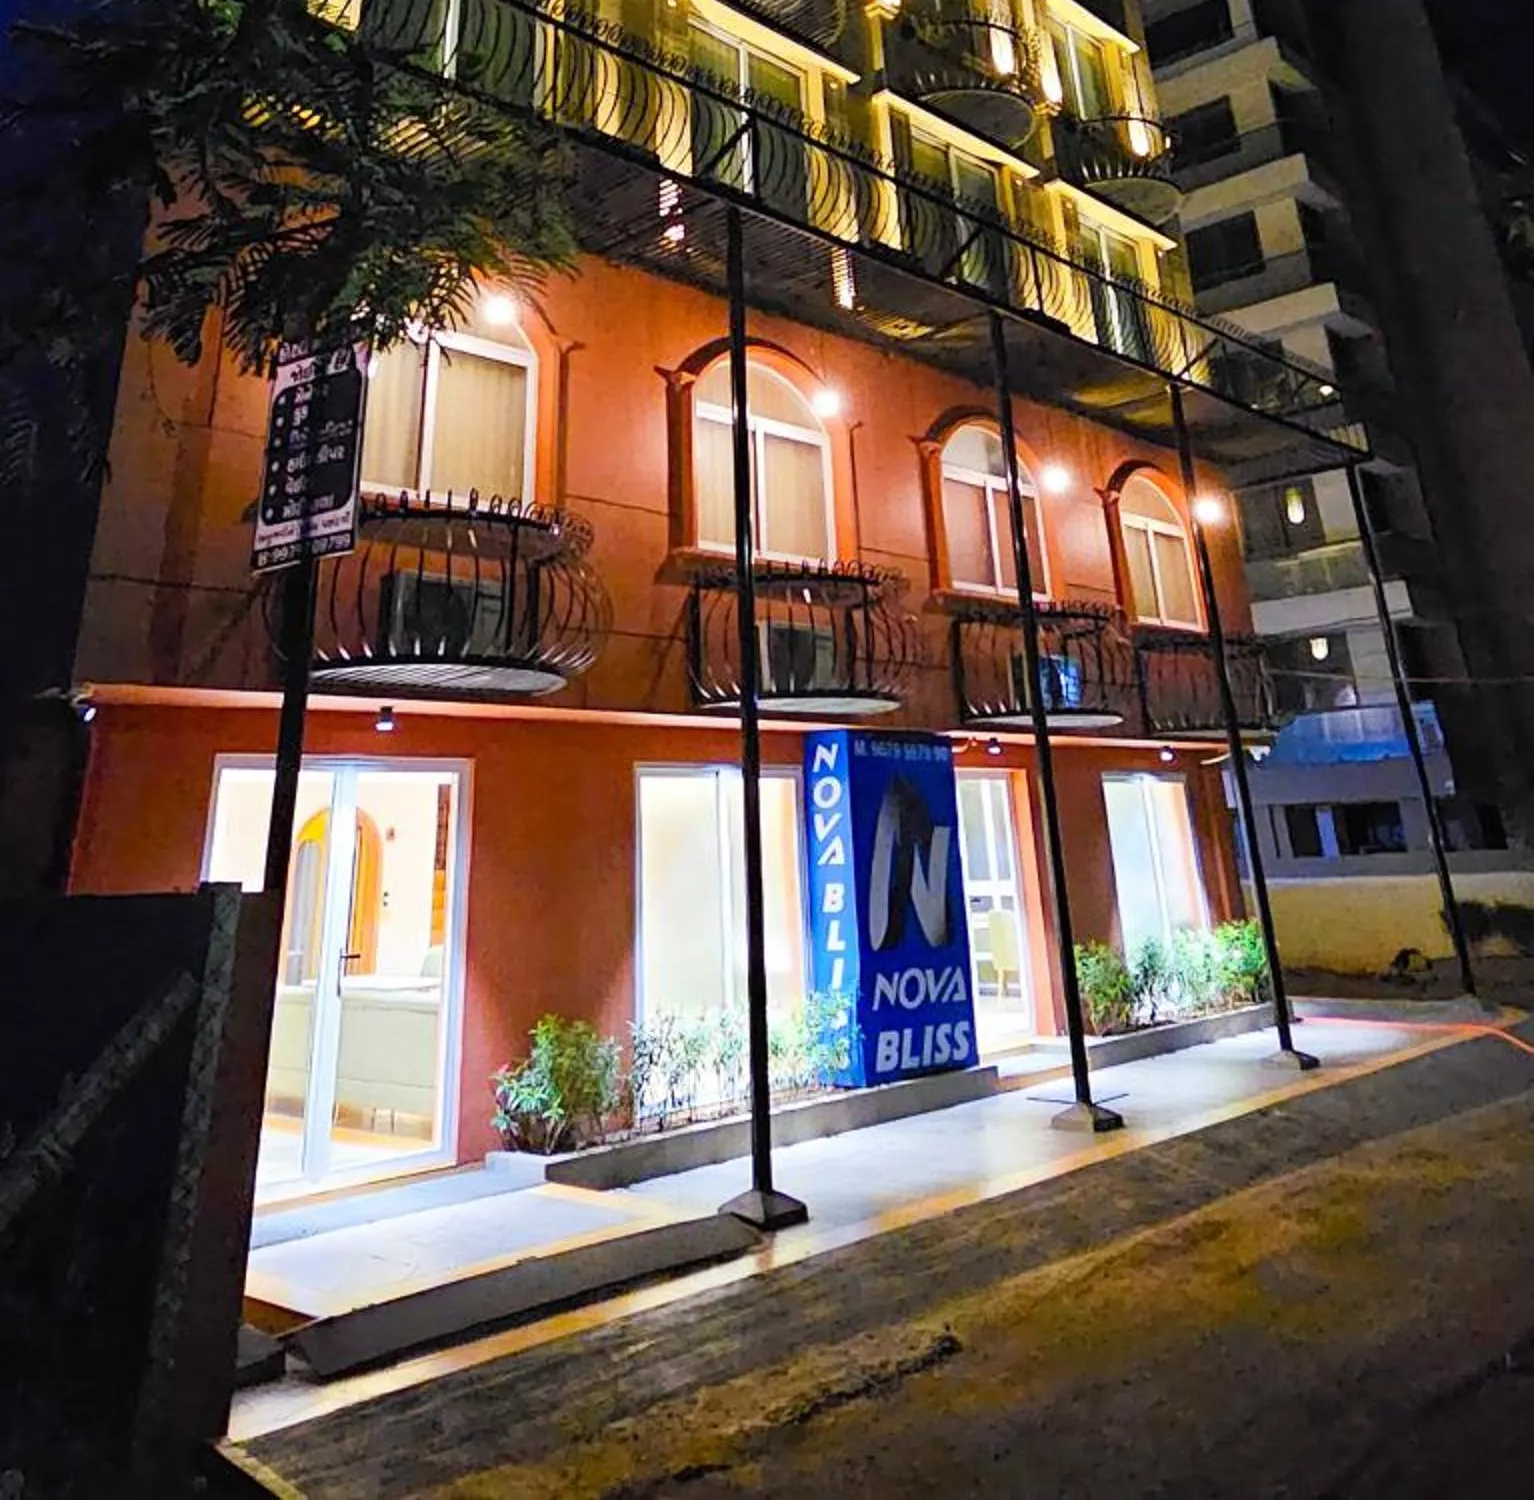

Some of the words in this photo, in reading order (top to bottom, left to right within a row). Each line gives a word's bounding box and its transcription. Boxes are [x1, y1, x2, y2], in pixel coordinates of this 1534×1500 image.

[812, 743, 846, 866] NOVA
[872, 966, 967, 1012] NOVA
[876, 1019, 972, 1074] BLISS
